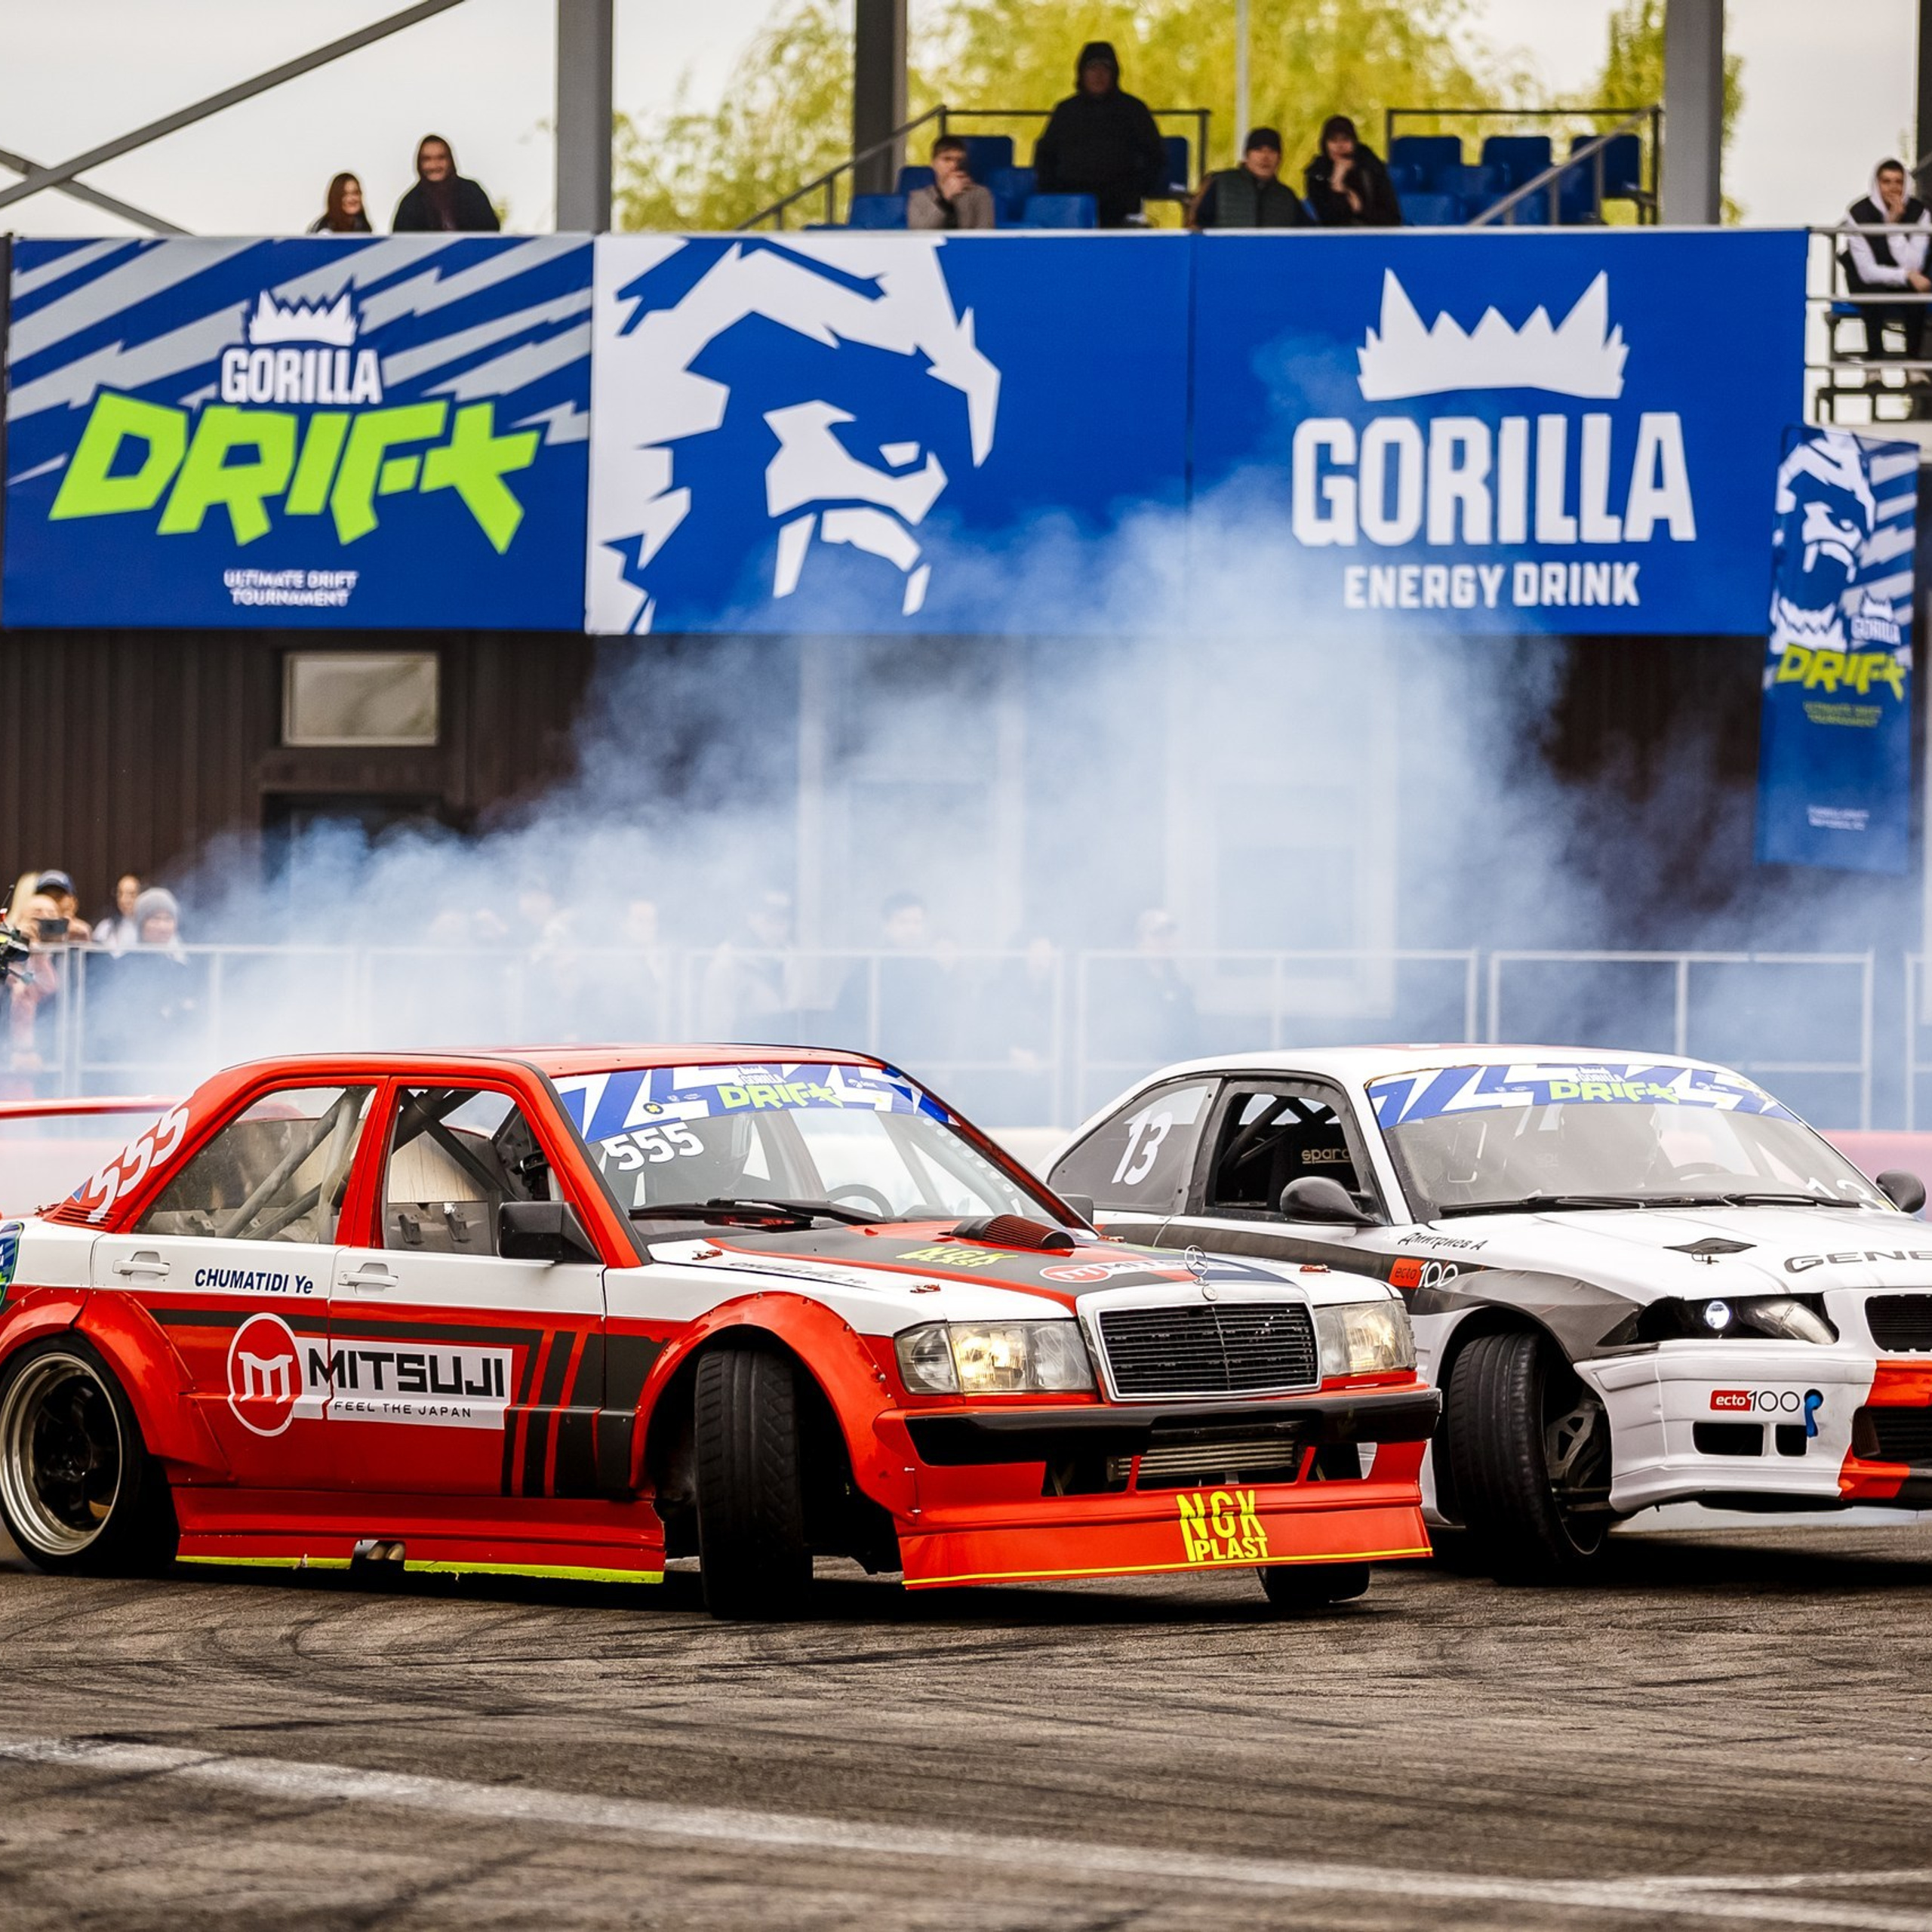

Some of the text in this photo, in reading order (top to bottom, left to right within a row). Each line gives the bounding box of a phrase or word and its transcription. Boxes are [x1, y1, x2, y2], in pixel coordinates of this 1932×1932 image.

[222, 349, 382, 405] GORILLA
[49, 392, 540, 554] DRIFT
[1292, 412, 1697, 546] GORILLA
[223, 569, 359, 589] ULTIMATE DRIFT
[230, 588, 351, 607] TOURNAMENT
[1343, 562, 1641, 609] ENERGY DRINK
[1777, 643, 1906, 701] DRIFT
[716, 1081, 844, 1109] DRIFT
[1549, 1081, 1680, 1105] DRIFT
[86, 1107, 189, 1223] 555
[599, 1121, 704, 1171] 555
[1112, 1110, 1173, 1186] 13
[195, 1269, 314, 1294] CHUMATIDI Ye
[308, 1348, 505, 1398] MITSUJI
[334, 1401, 472, 1418] FEEL THE JAPAN
[1176, 1489, 1266, 1562] NGK
[1193, 1537, 1268, 1561] PLAST
